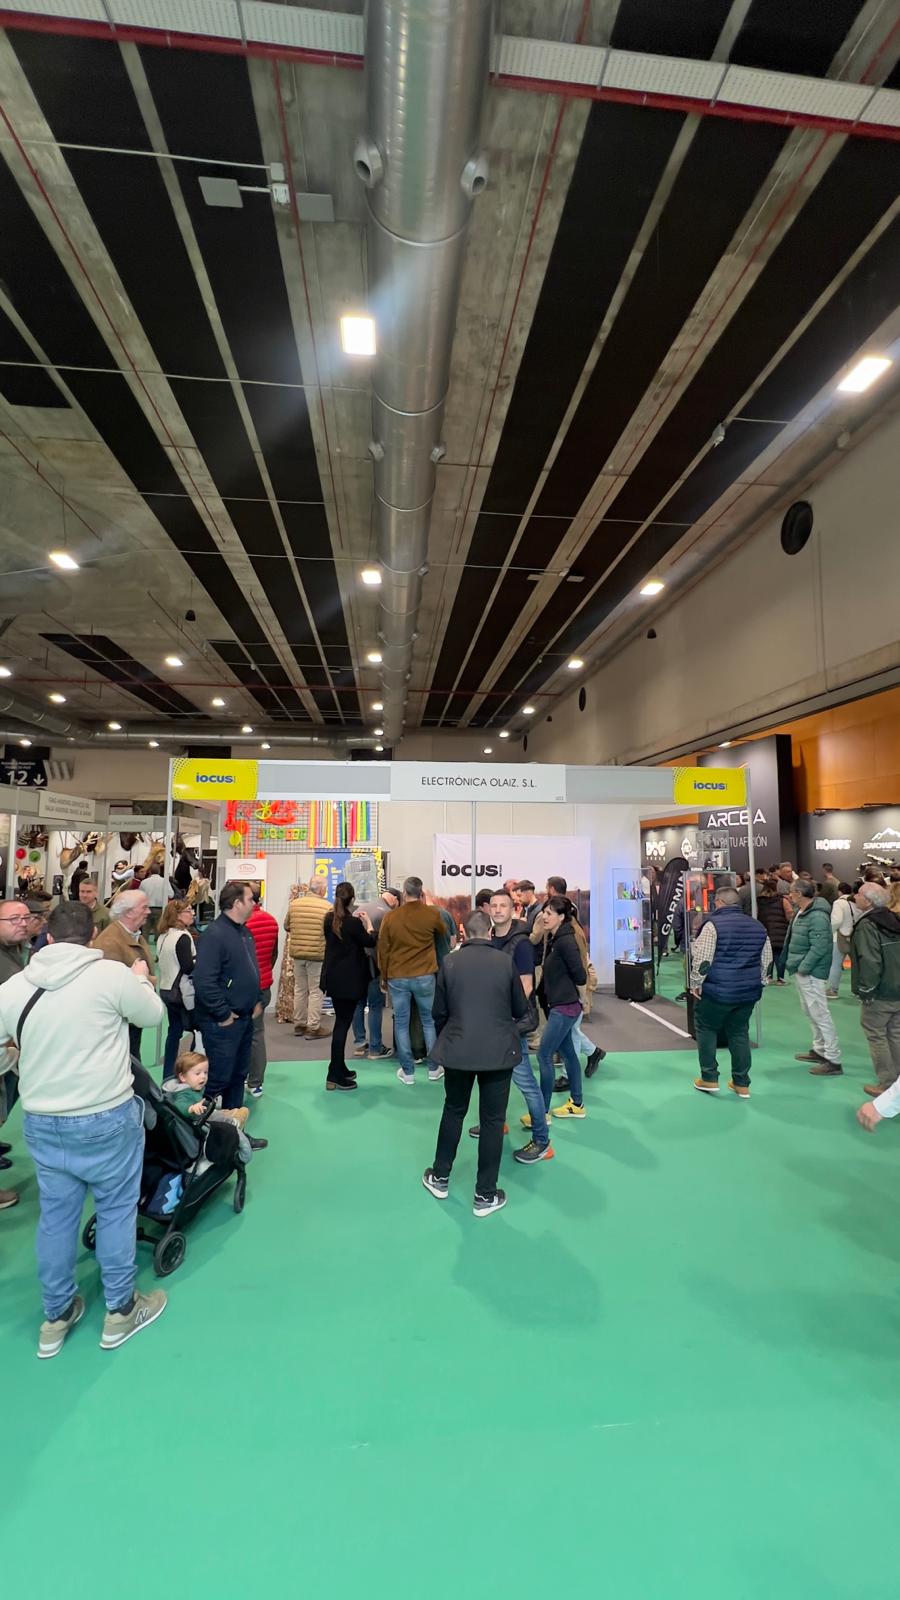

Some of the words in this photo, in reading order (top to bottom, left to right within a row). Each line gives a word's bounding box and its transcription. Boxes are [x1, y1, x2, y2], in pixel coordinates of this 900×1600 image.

[7, 770, 28, 785] 12
[196, 772, 234, 783] iocus
[421, 775, 487, 787] ELECTRÓNICA
[522, 778, 537, 788] S.L.
[693, 780, 726, 790] iocus
[739, 833, 768, 848] AFIÓN
[441, 860, 499, 877] iocus
